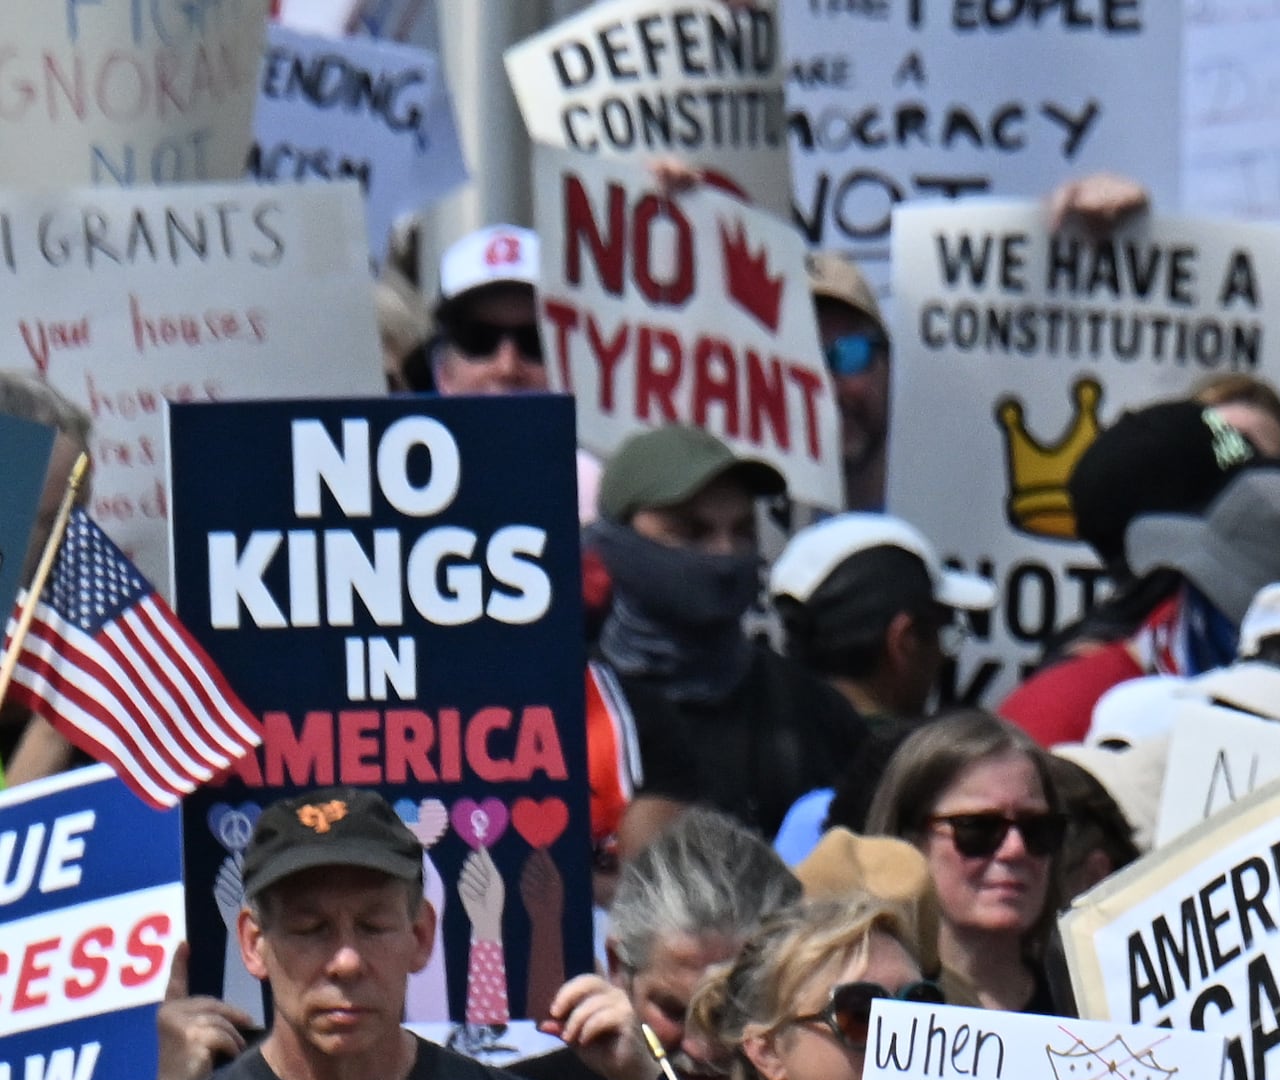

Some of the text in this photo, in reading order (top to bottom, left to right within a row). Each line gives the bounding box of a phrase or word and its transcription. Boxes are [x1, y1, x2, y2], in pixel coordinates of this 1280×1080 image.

[552, 8, 777, 90] DEFEND
[562, 172, 696, 307] NO
[938, 233, 1261, 310] WE HAVE A
[545, 297, 826, 465] TYRANT
[920, 302, 1264, 372] CONSTITUTION
[290, 416, 461, 519] NO
[207, 526, 553, 629] KINGS
[345, 637, 417, 701] IN
[216, 705, 568, 787] AMERICA
[0, 913, 172, 1012] ESS
